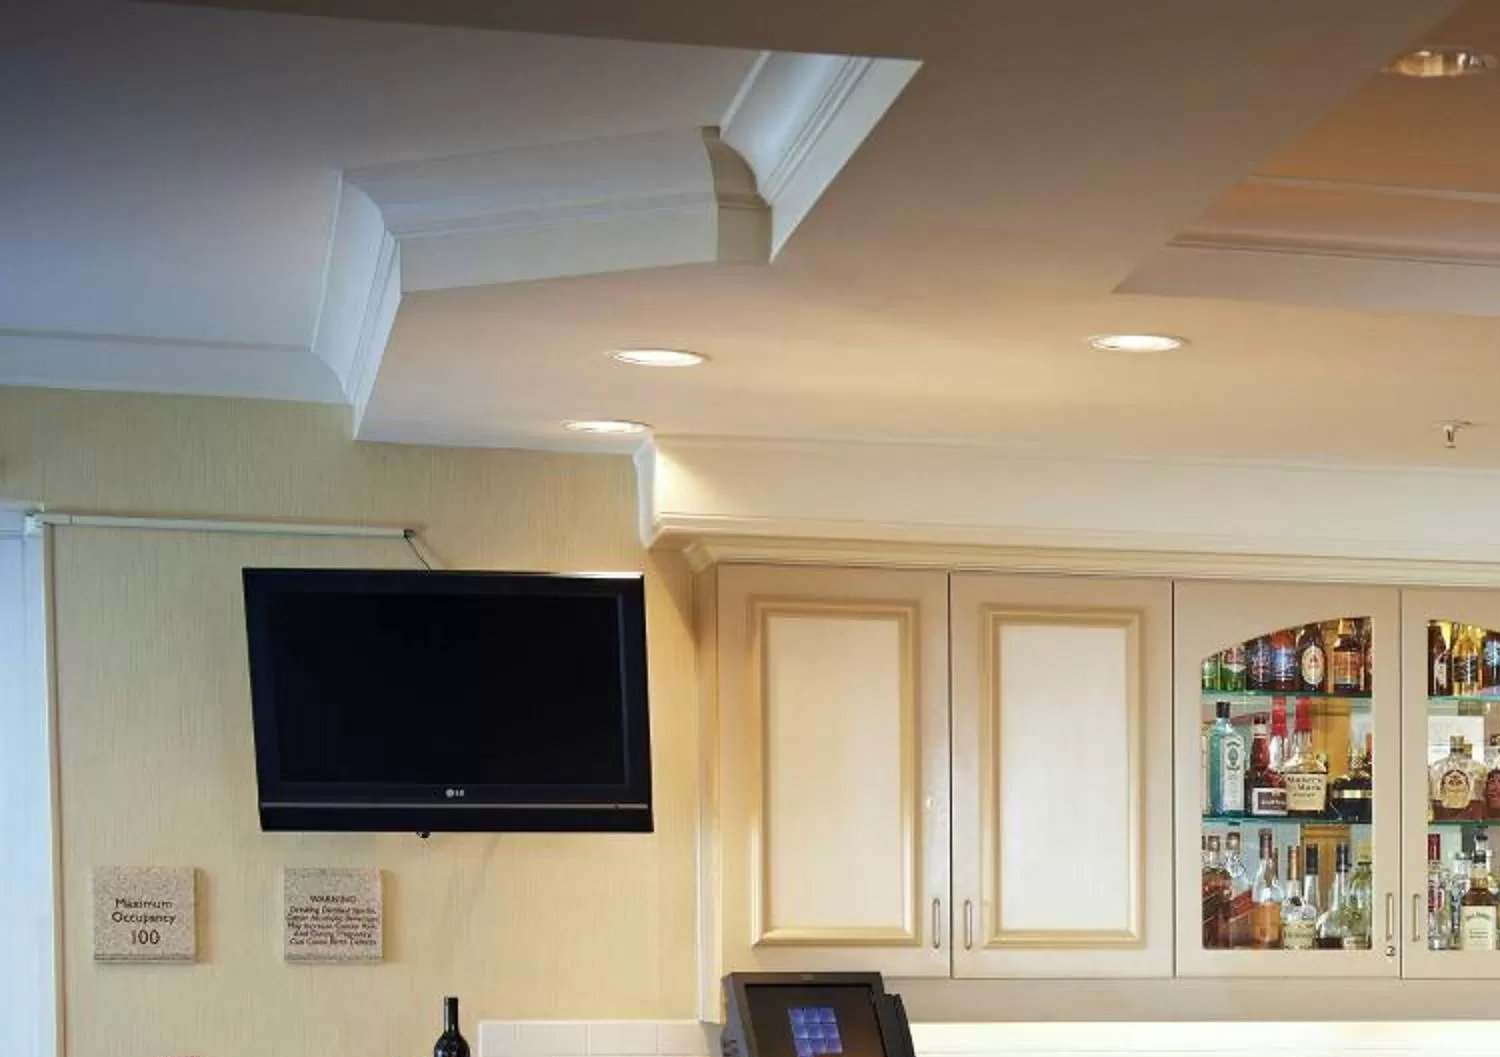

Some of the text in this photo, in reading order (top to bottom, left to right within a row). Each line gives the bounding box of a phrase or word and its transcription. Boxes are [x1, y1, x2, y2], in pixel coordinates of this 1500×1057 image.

[115, 898, 173, 909] Maximum
[111, 911, 176, 925] Occupancy
[131, 929, 161, 945] 100
